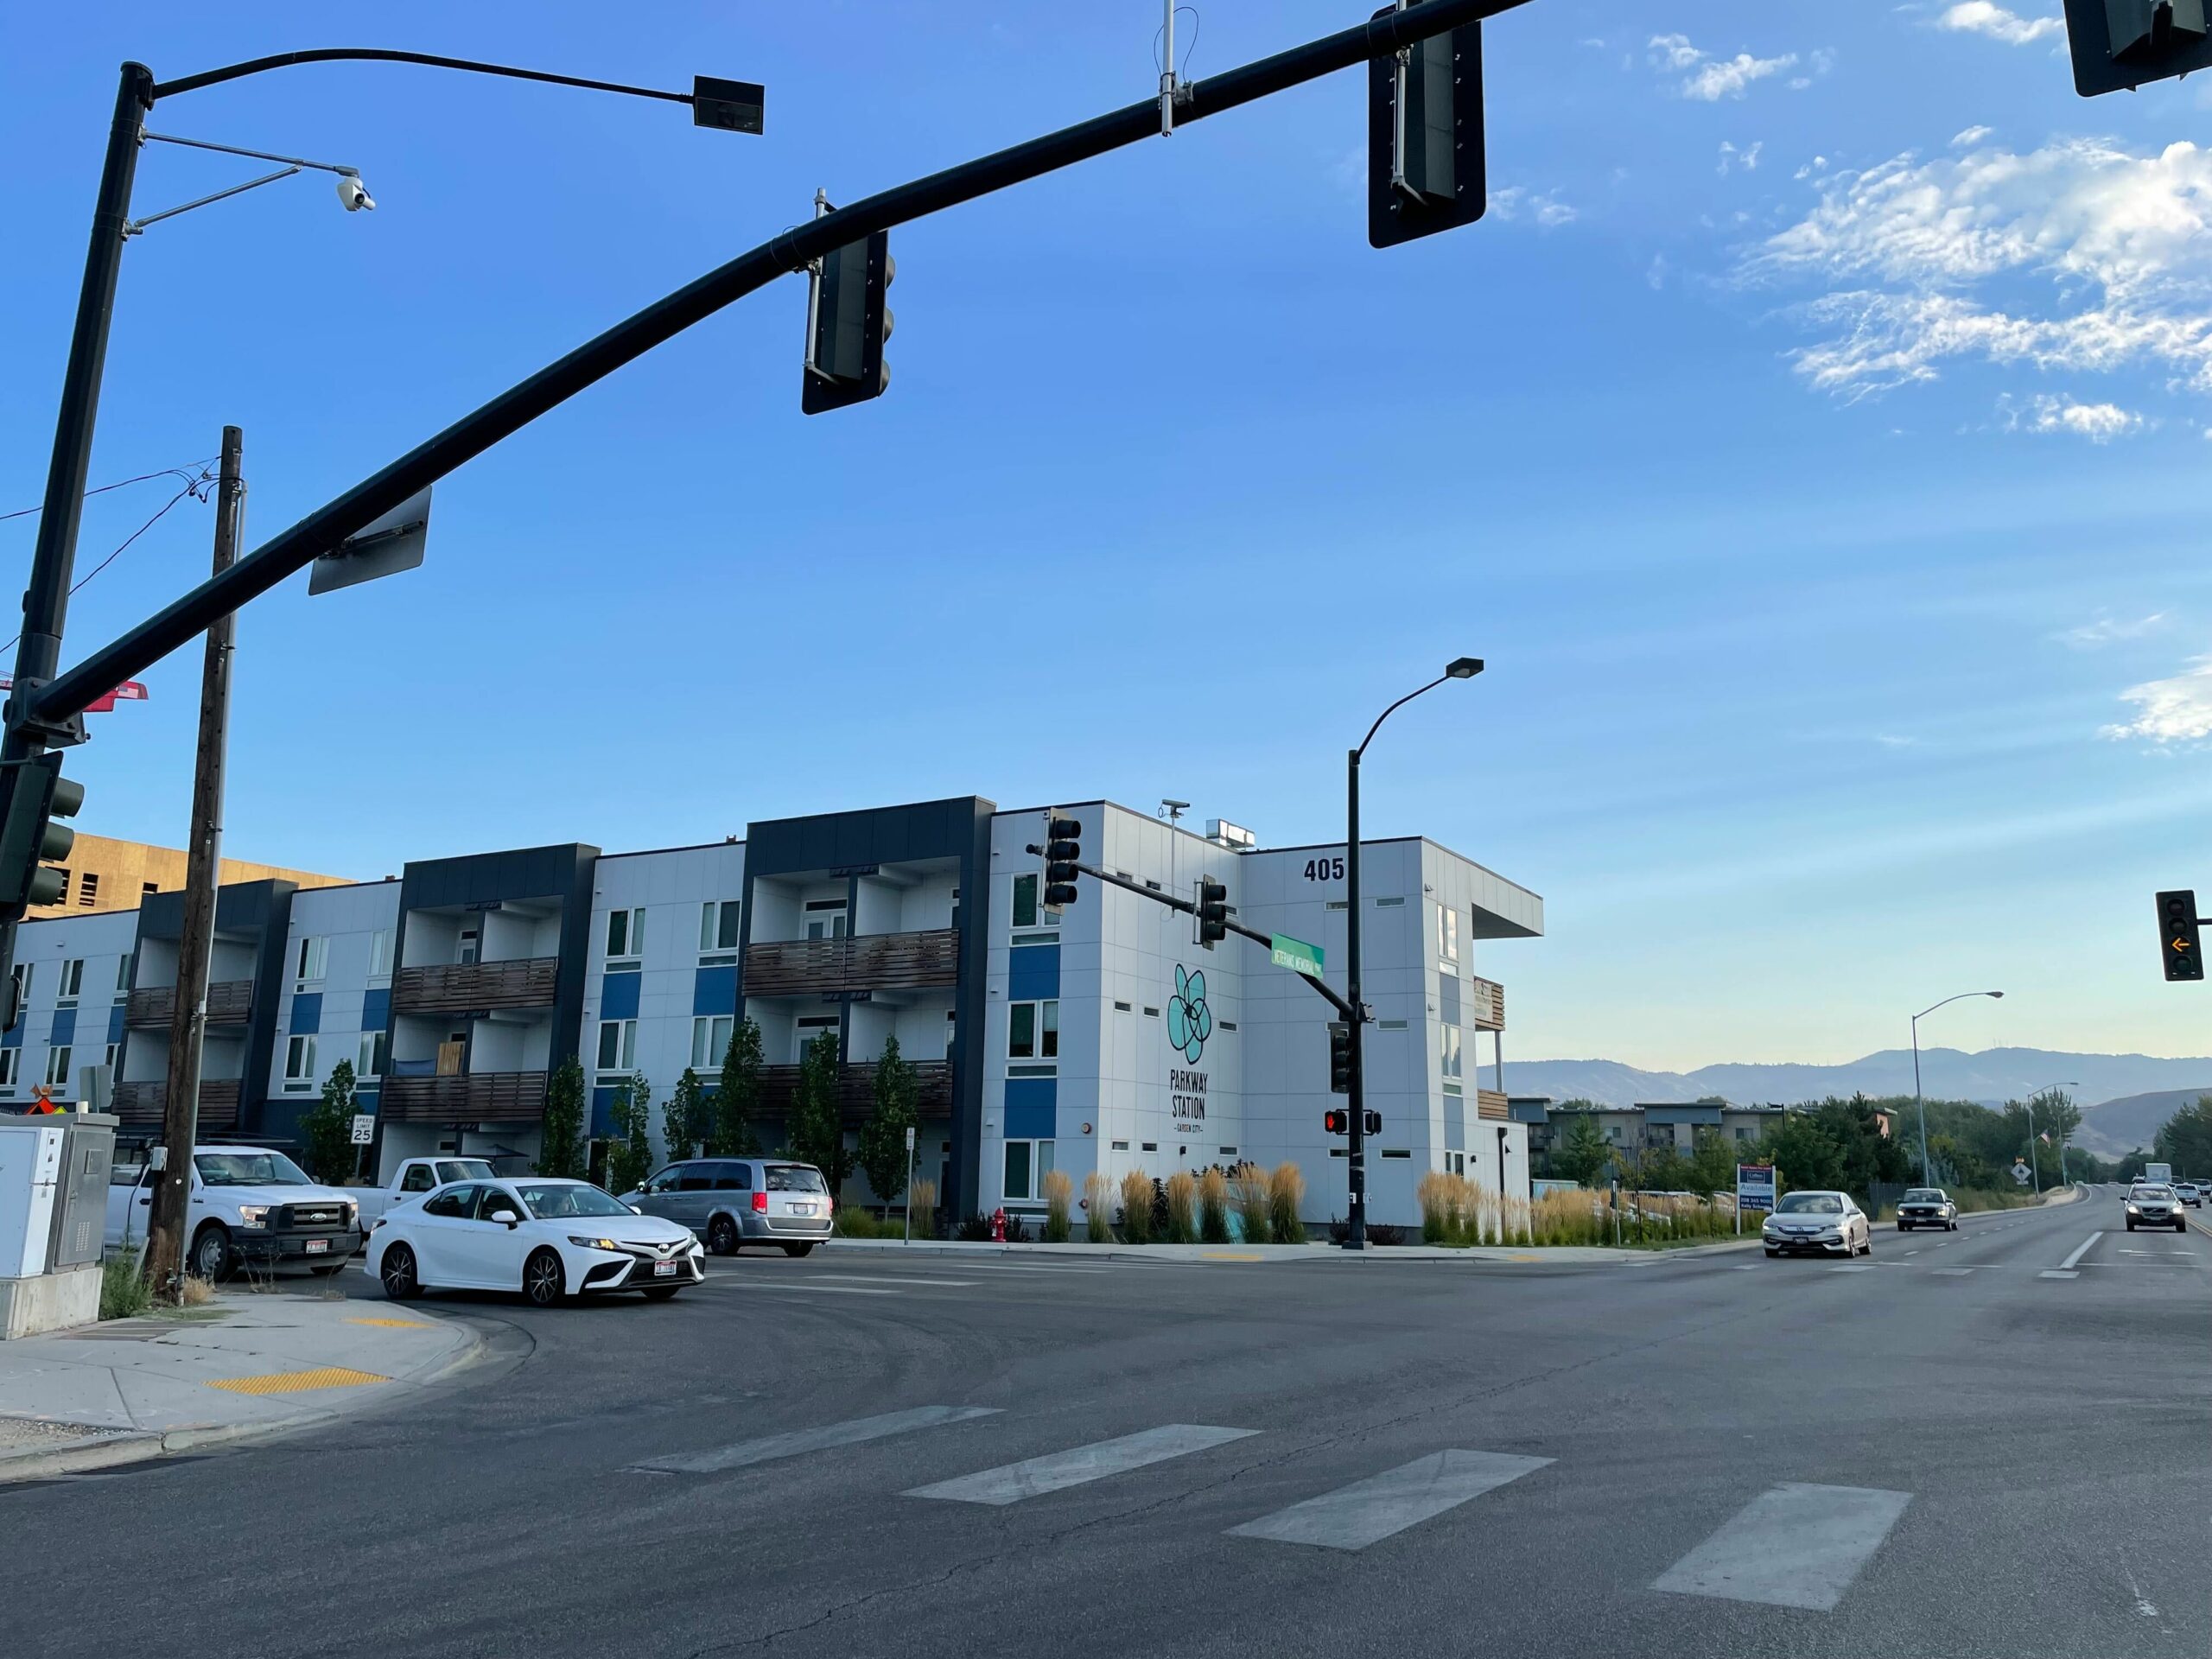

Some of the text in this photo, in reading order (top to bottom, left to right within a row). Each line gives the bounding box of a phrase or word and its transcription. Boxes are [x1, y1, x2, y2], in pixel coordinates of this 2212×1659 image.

[1304, 857, 1344, 881] 405
[1274, 949, 1294, 969] VETERANS
[1295, 956, 1314, 975] MEMORIAL
[1170, 1069, 1208, 1095] PARKWAY
[1173, 1095, 1205, 1121] STATION
[353, 1129, 371, 1141] 25
